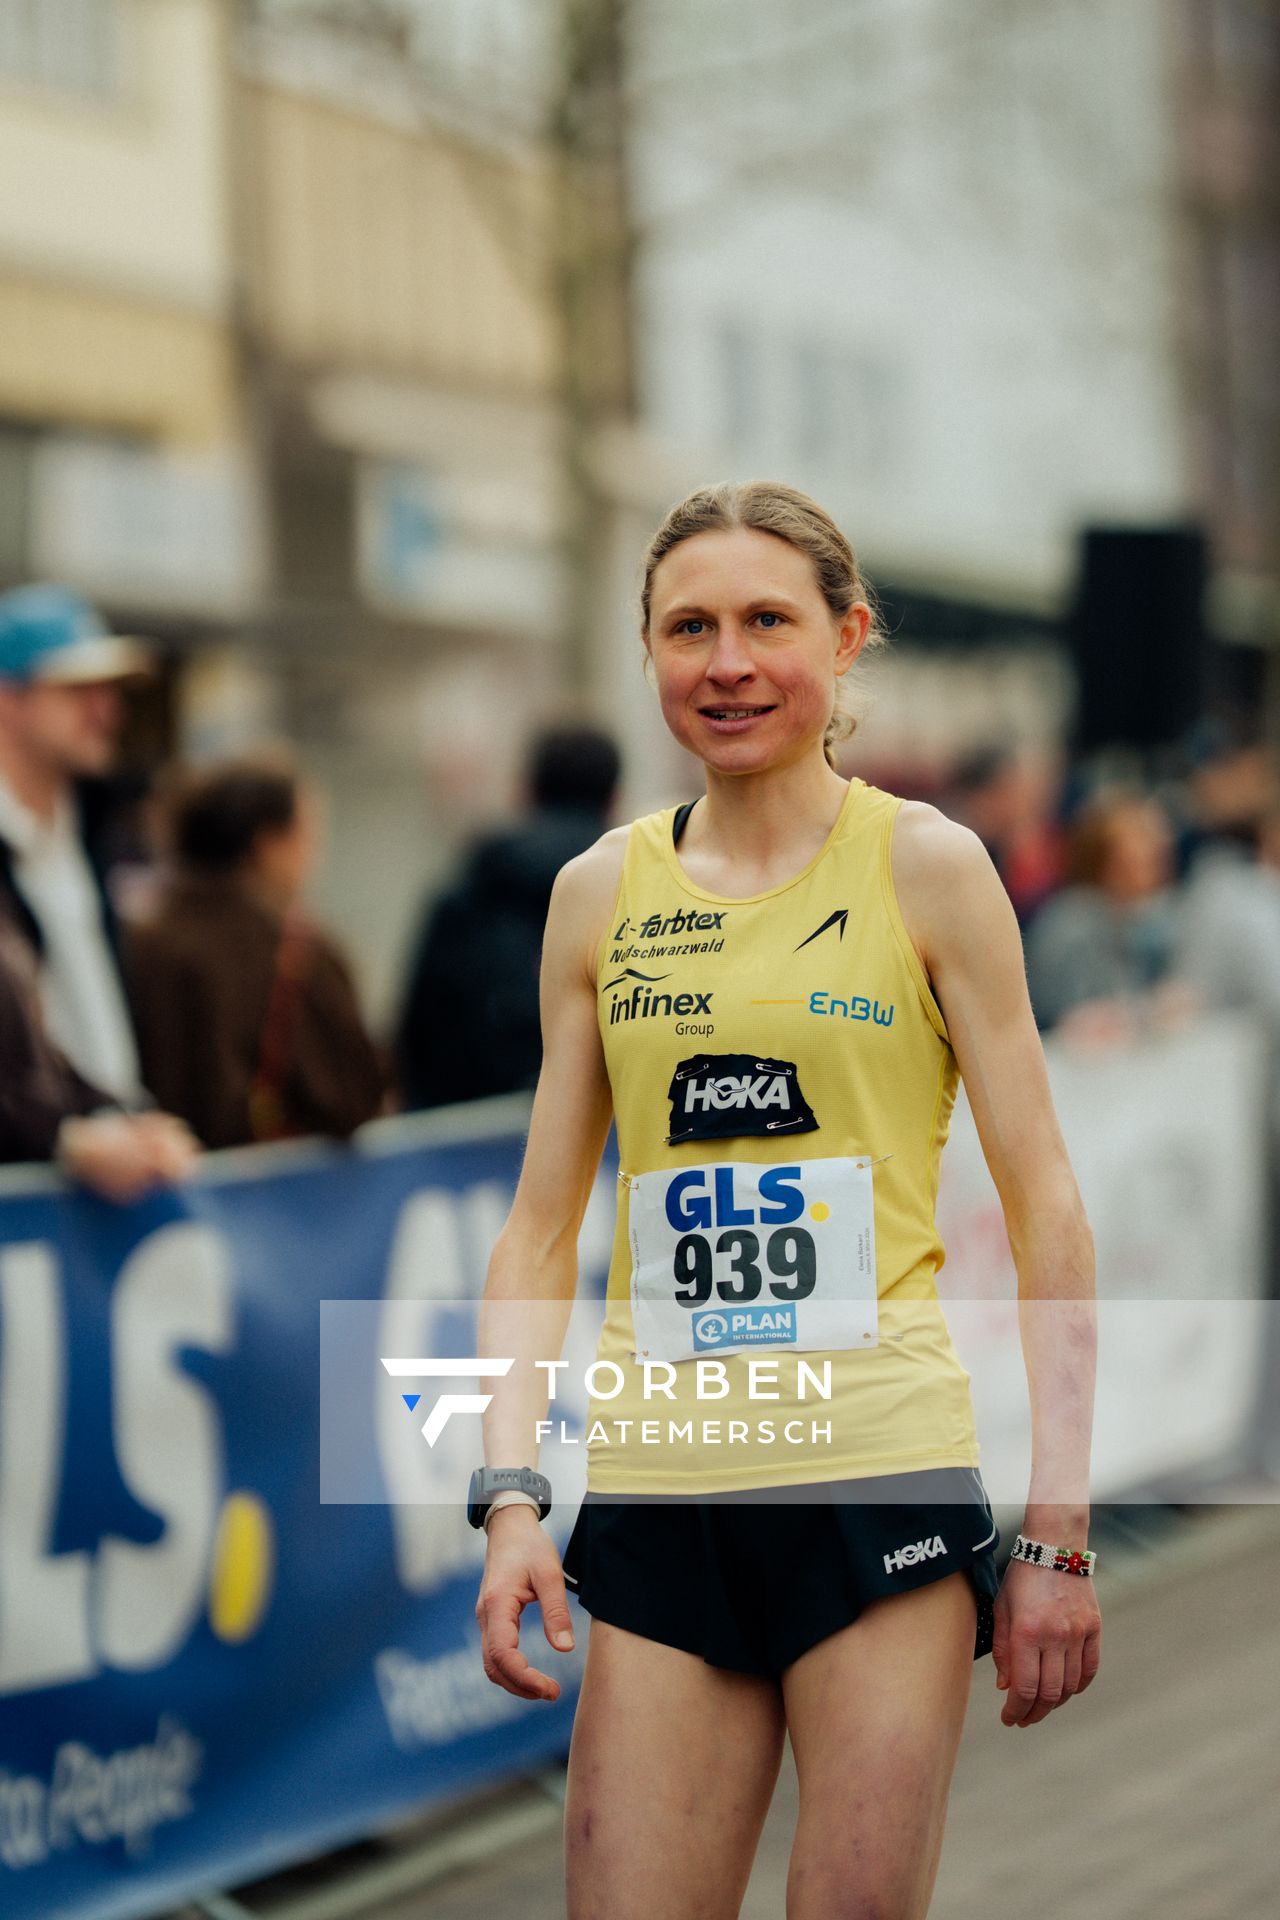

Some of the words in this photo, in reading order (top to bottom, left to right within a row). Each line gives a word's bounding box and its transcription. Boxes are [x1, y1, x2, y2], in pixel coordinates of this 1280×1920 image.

[639, 908, 729, 939] farbtex
[610, 986, 714, 1025] infinex
[809, 991, 894, 1027] EnBW
[675, 1021, 715, 1038] Group
[684, 1075, 791, 1113] HOKA
[673, 1226, 817, 1309] 939
[732, 1311, 791, 1332] PLAN
[732, 1332, 792, 1341] INTERNATIONAL
[882, 1535, 949, 1575] HOKA
